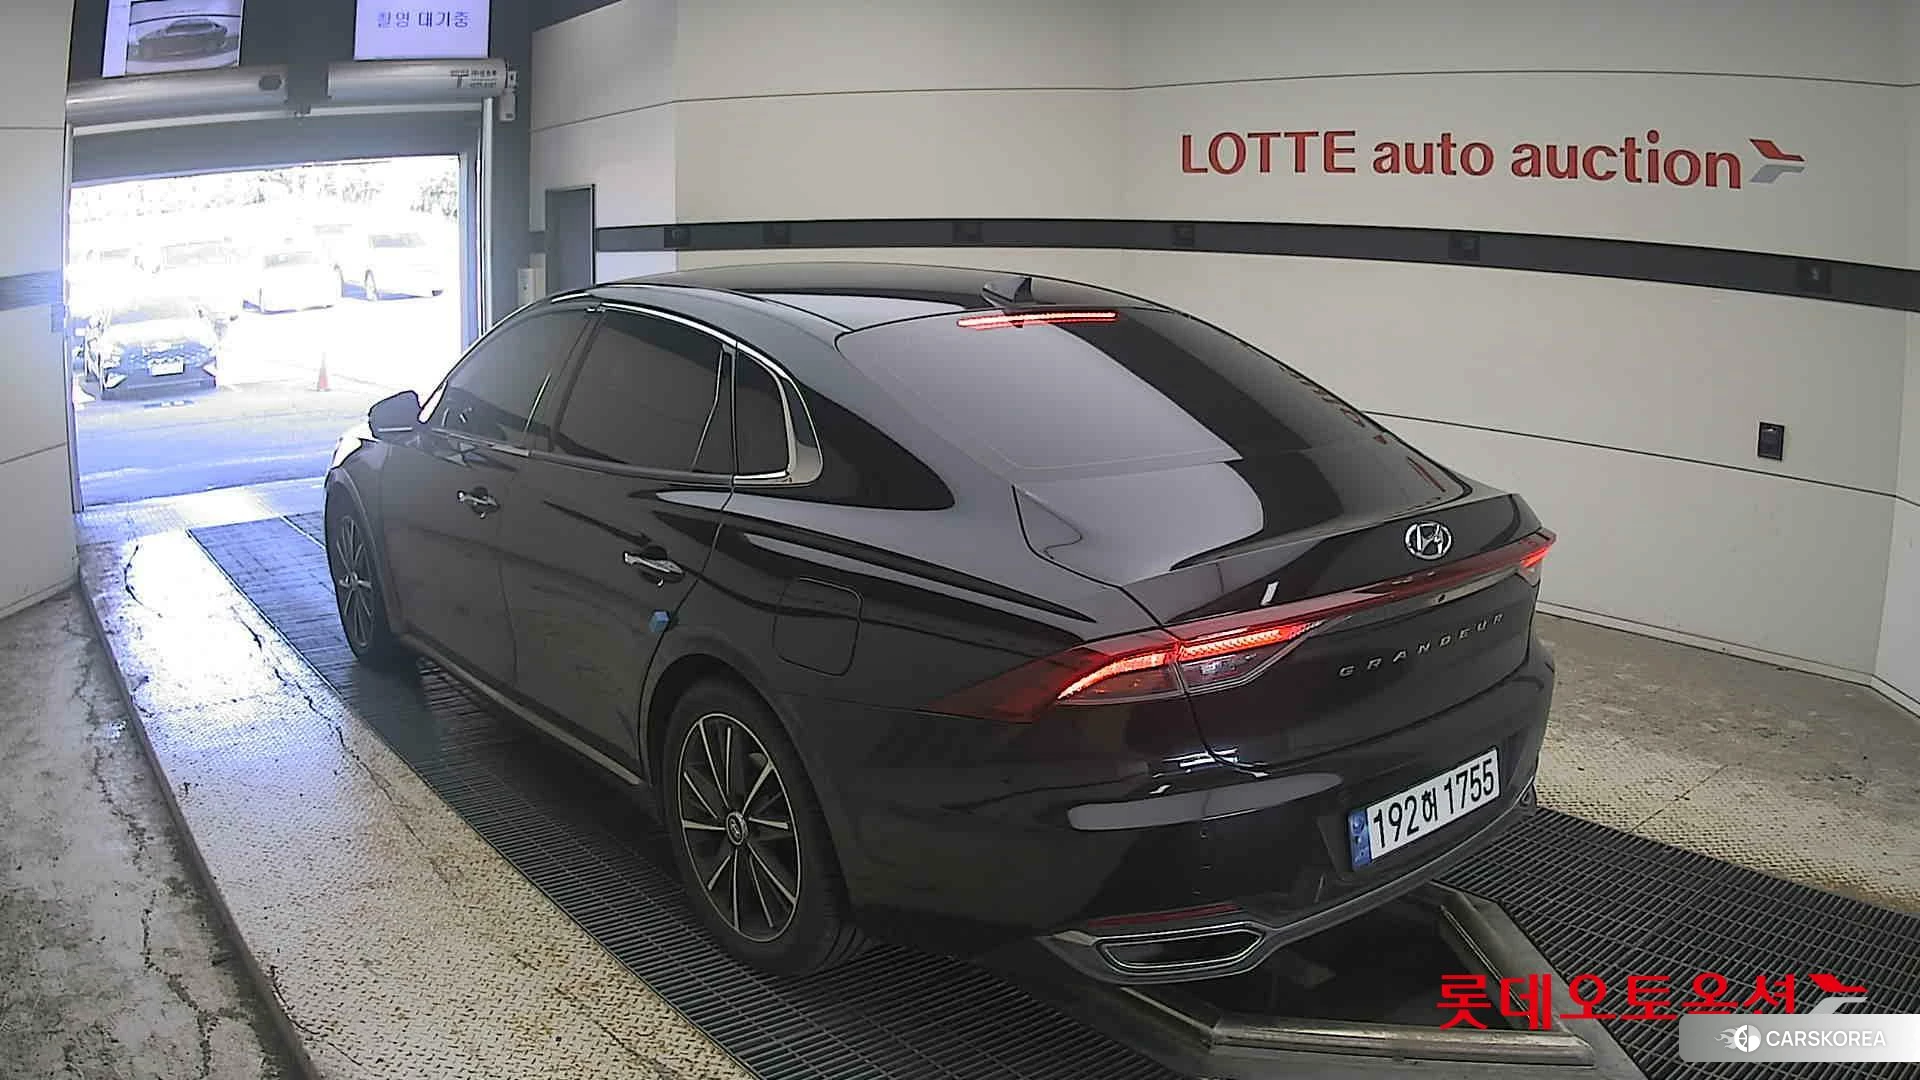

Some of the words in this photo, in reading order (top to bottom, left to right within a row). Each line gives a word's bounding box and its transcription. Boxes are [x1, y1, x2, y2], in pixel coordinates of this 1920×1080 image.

[418, 10, 469, 28] 대기중
[1181, 130, 1357, 175] LOTTE
[1372, 132, 1495, 177] auto
[1510, 129, 1742, 189] auction
[1339, 613, 1503, 677] GRANDEUR
[1373, 787, 1438, 849] 192허
[1444, 758, 1494, 815] 1755
